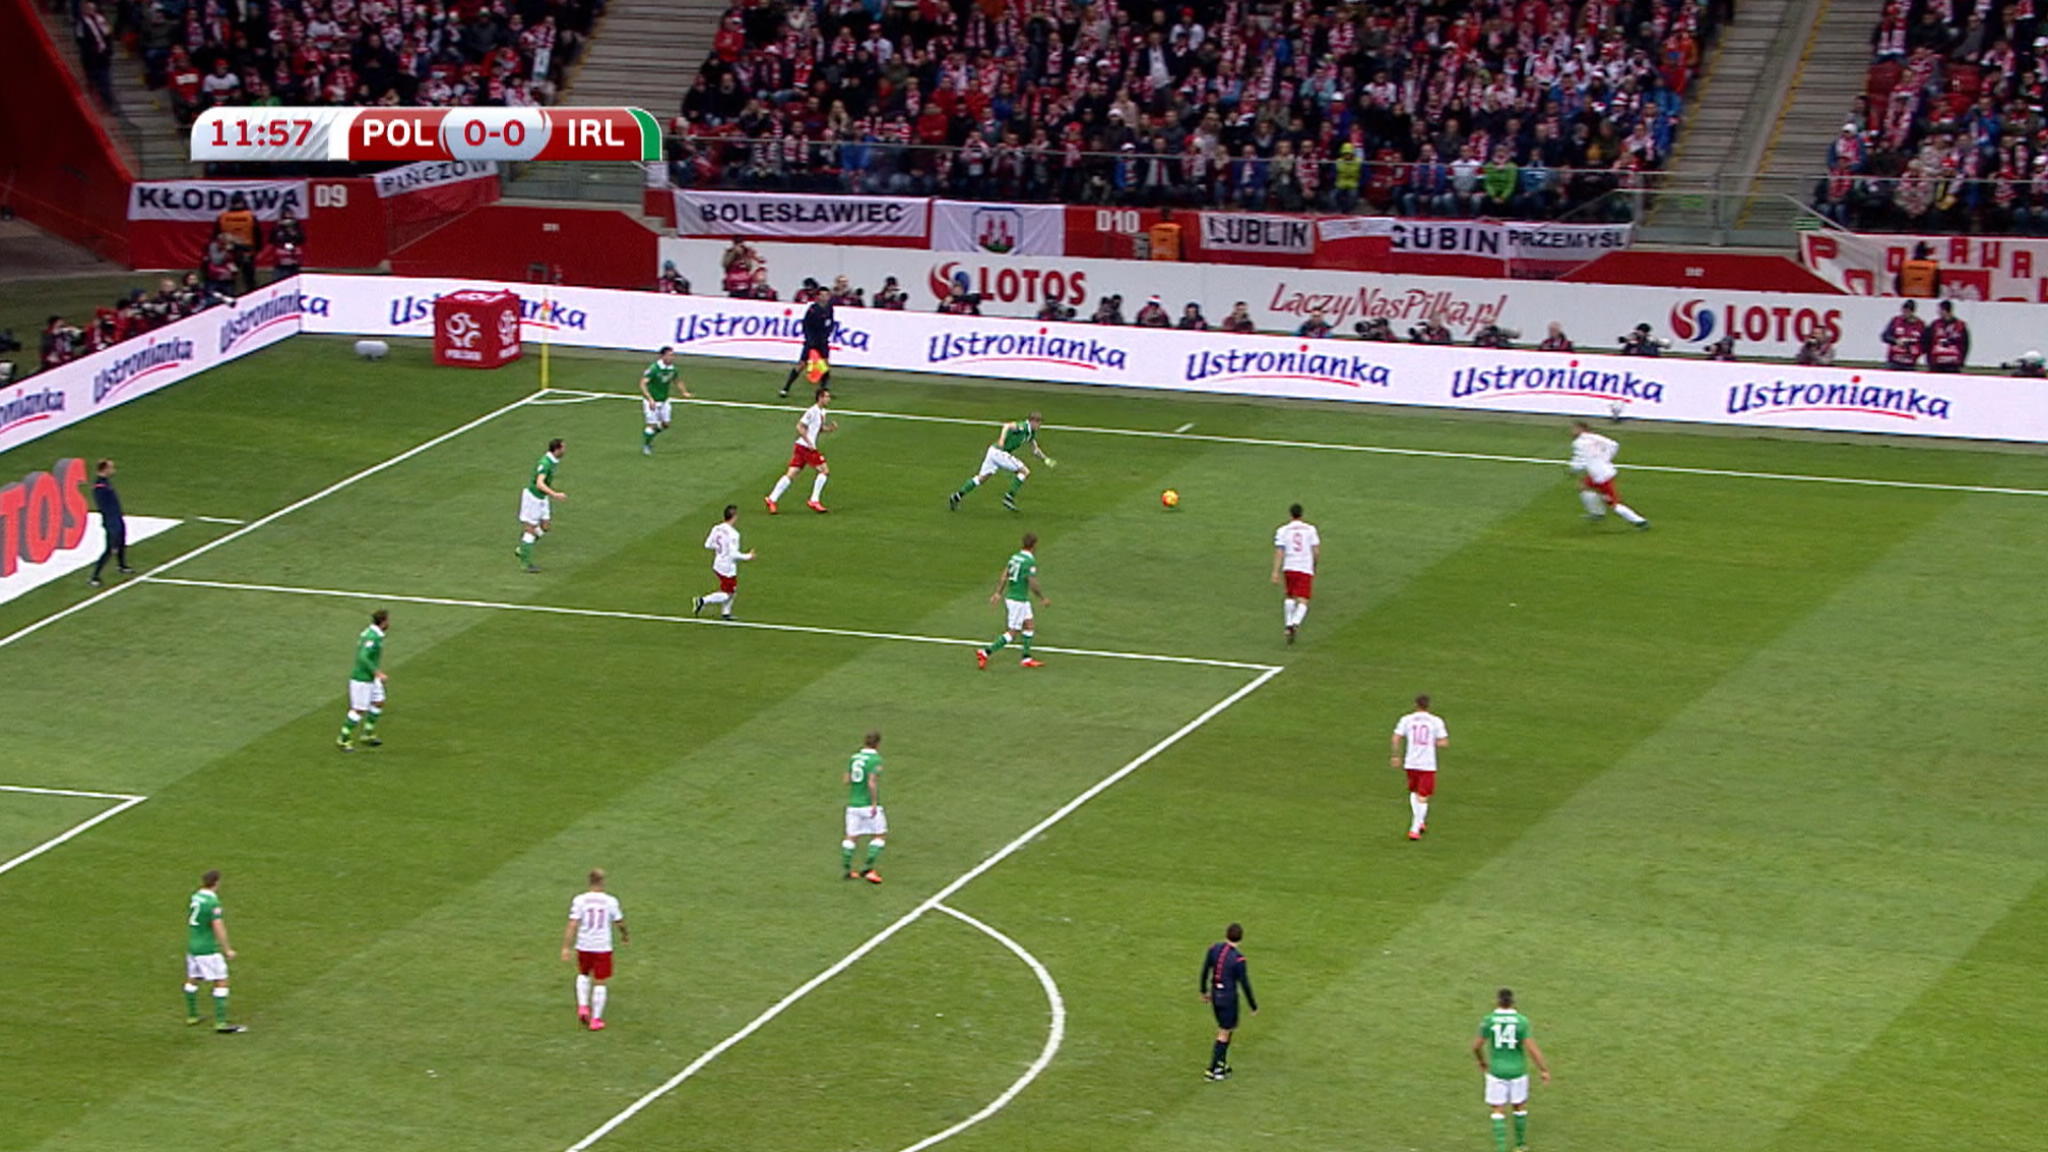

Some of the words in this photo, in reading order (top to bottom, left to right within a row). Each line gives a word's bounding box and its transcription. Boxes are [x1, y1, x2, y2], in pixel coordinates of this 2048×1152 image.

[314, 184, 348, 208] D9
[700, 203, 904, 223] BOLESŁAWIEC
[1095, 209, 1141, 233] D10
[1208, 217, 1308, 248] LUBLIN
[978, 266, 1087, 307] LOTOS
[675, 308, 870, 351] Ustroniaka
[1724, 304, 1842, 344] LOTOS
[927, 327, 1127, 370] Ustronianka
[1185, 344, 1391, 387] Ustronianka
[1451, 360, 1665, 403] Ustronianka
[1726, 375, 1950, 420] Ustronianka
[1292, 532, 1304, 553] 9
[1411, 723, 1430, 745] 10
[850, 758, 865, 783] 6
[188, 900, 201, 926] 2
[586, 908, 607, 931] 11
[1490, 1023, 1518, 1050] 14
